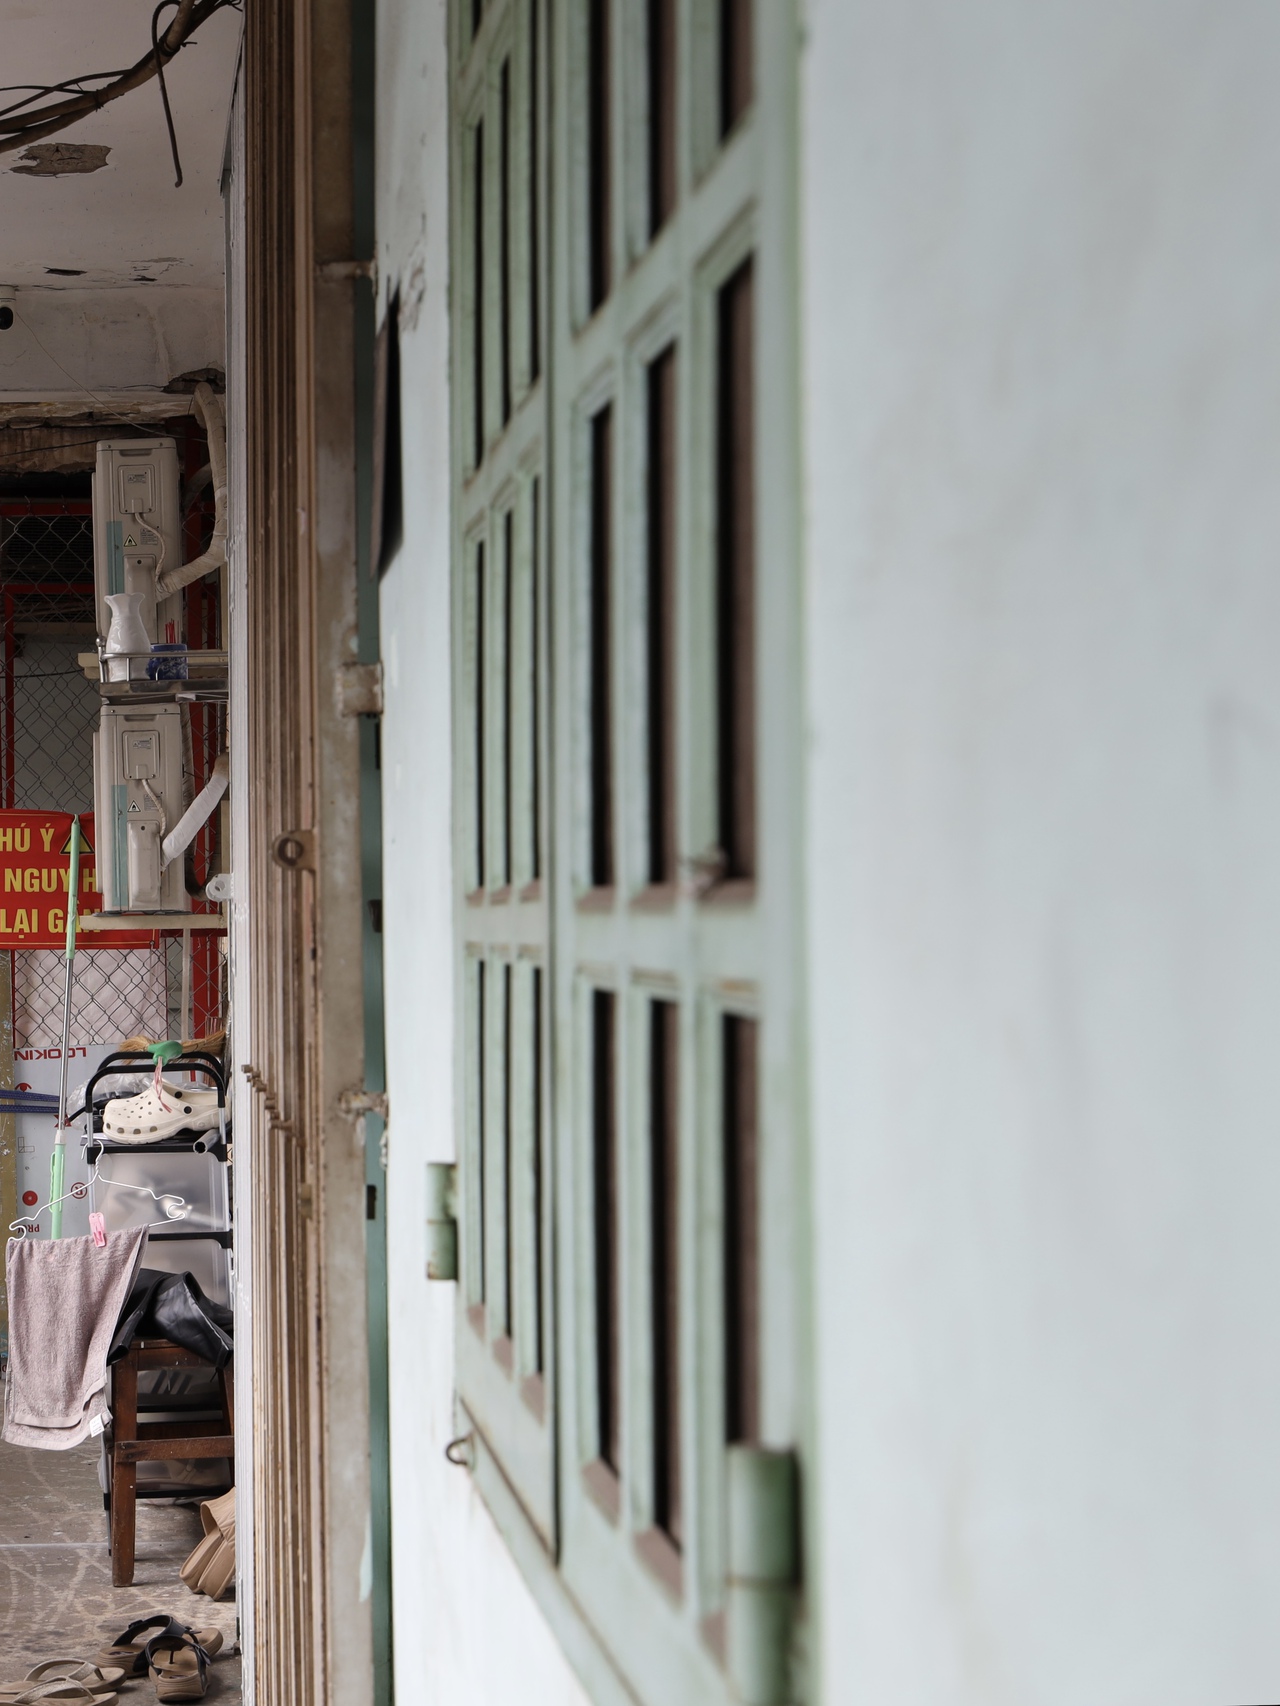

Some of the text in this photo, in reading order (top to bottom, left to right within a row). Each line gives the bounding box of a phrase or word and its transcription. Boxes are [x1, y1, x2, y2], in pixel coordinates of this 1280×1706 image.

[40, 823, 55, 853] Ý
[4, 868, 70, 893] NGUY
[0, 908, 39, 939] LẠI
